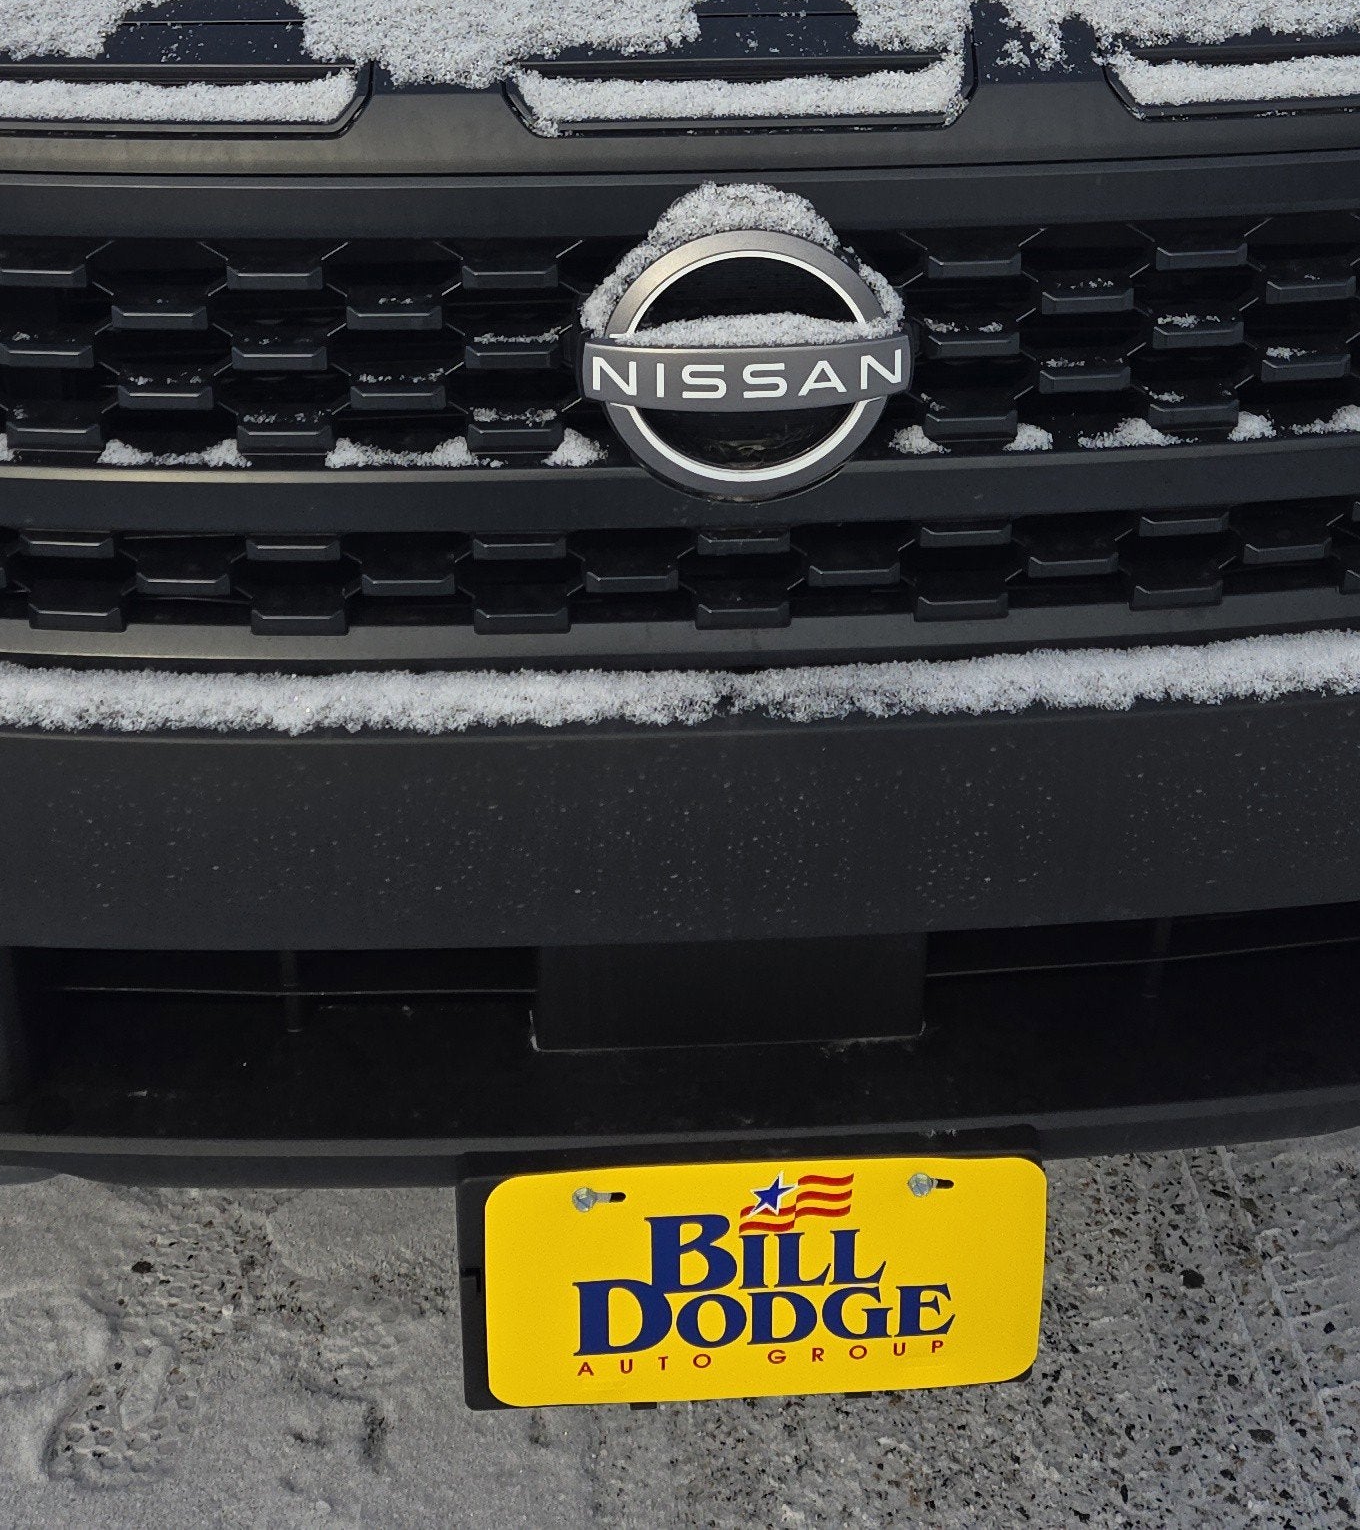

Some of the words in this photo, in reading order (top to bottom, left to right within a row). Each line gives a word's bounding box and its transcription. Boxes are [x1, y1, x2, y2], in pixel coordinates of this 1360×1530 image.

[592, 348, 902, 399] NISSAN
[645, 1213, 887, 1294] BILL
[572, 1278, 956, 1357] DODGE
[576, 1352, 713, 1377] AUTO
[766, 1338, 944, 1365] GROUP
